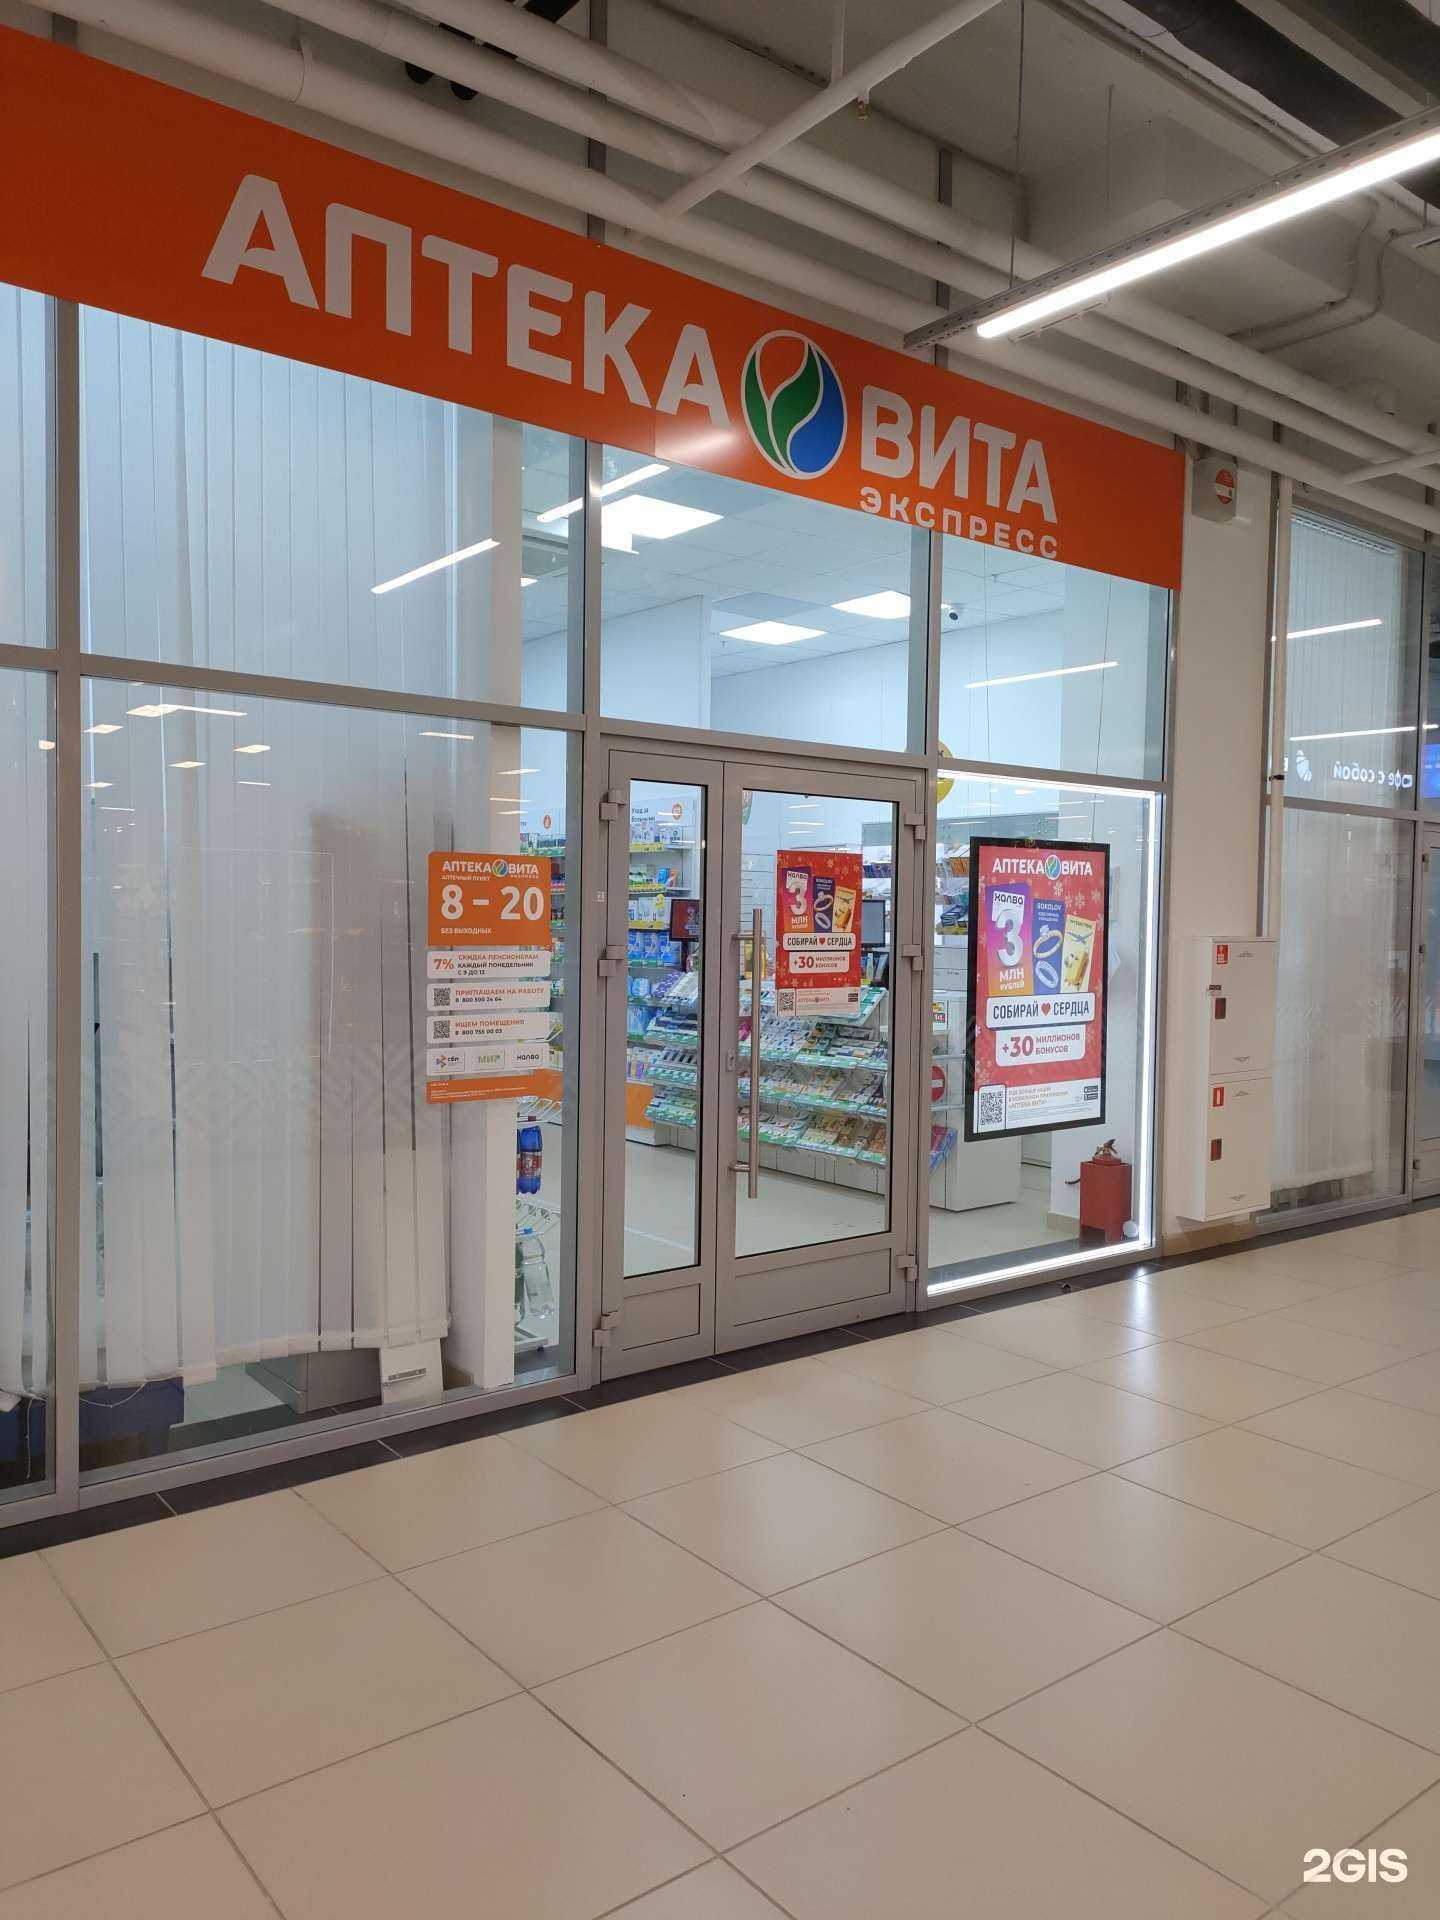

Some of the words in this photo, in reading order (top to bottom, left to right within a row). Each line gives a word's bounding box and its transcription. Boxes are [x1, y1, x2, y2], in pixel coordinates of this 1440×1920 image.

[201, 174, 731, 429] АПТЕКА
[861, 385, 1057, 524] ВИТА
[860, 487, 1058, 559] ЭКСПРЕСС
[442, 861, 492, 873] АПТЕКА
[508, 864, 539, 874] ВИТА
[992, 858, 1045, 873] АПТЕКА
[1061, 861, 1093, 876] ВИТА
[441, 884, 464, 920] 8
[500, 886, 544, 920] 20
[788, 881, 807, 915] 3
[1037, 902, 1062, 911] SOKOLOV
[791, 915, 808, 923] МЛН
[787, 936, 817, 946] СОБИРАЙ
[827, 937, 852, 946] СЕРДЦА
[997, 909, 1023, 967] 3
[433, 959, 454, 970] 7%
[794, 956, 814, 968] +30
[999, 967, 1025, 981] МЛН
[993, 1001, 1039, 1020] СОБИРАЙ
[1053, 1000, 1090, 1017] СЕРДЦА
[1035, 1033, 1081, 1044] МИЛЛИОНОВ
[1002, 1035, 1034, 1058] +30
[1035, 1044, 1069, 1055] БОНУСОВ
